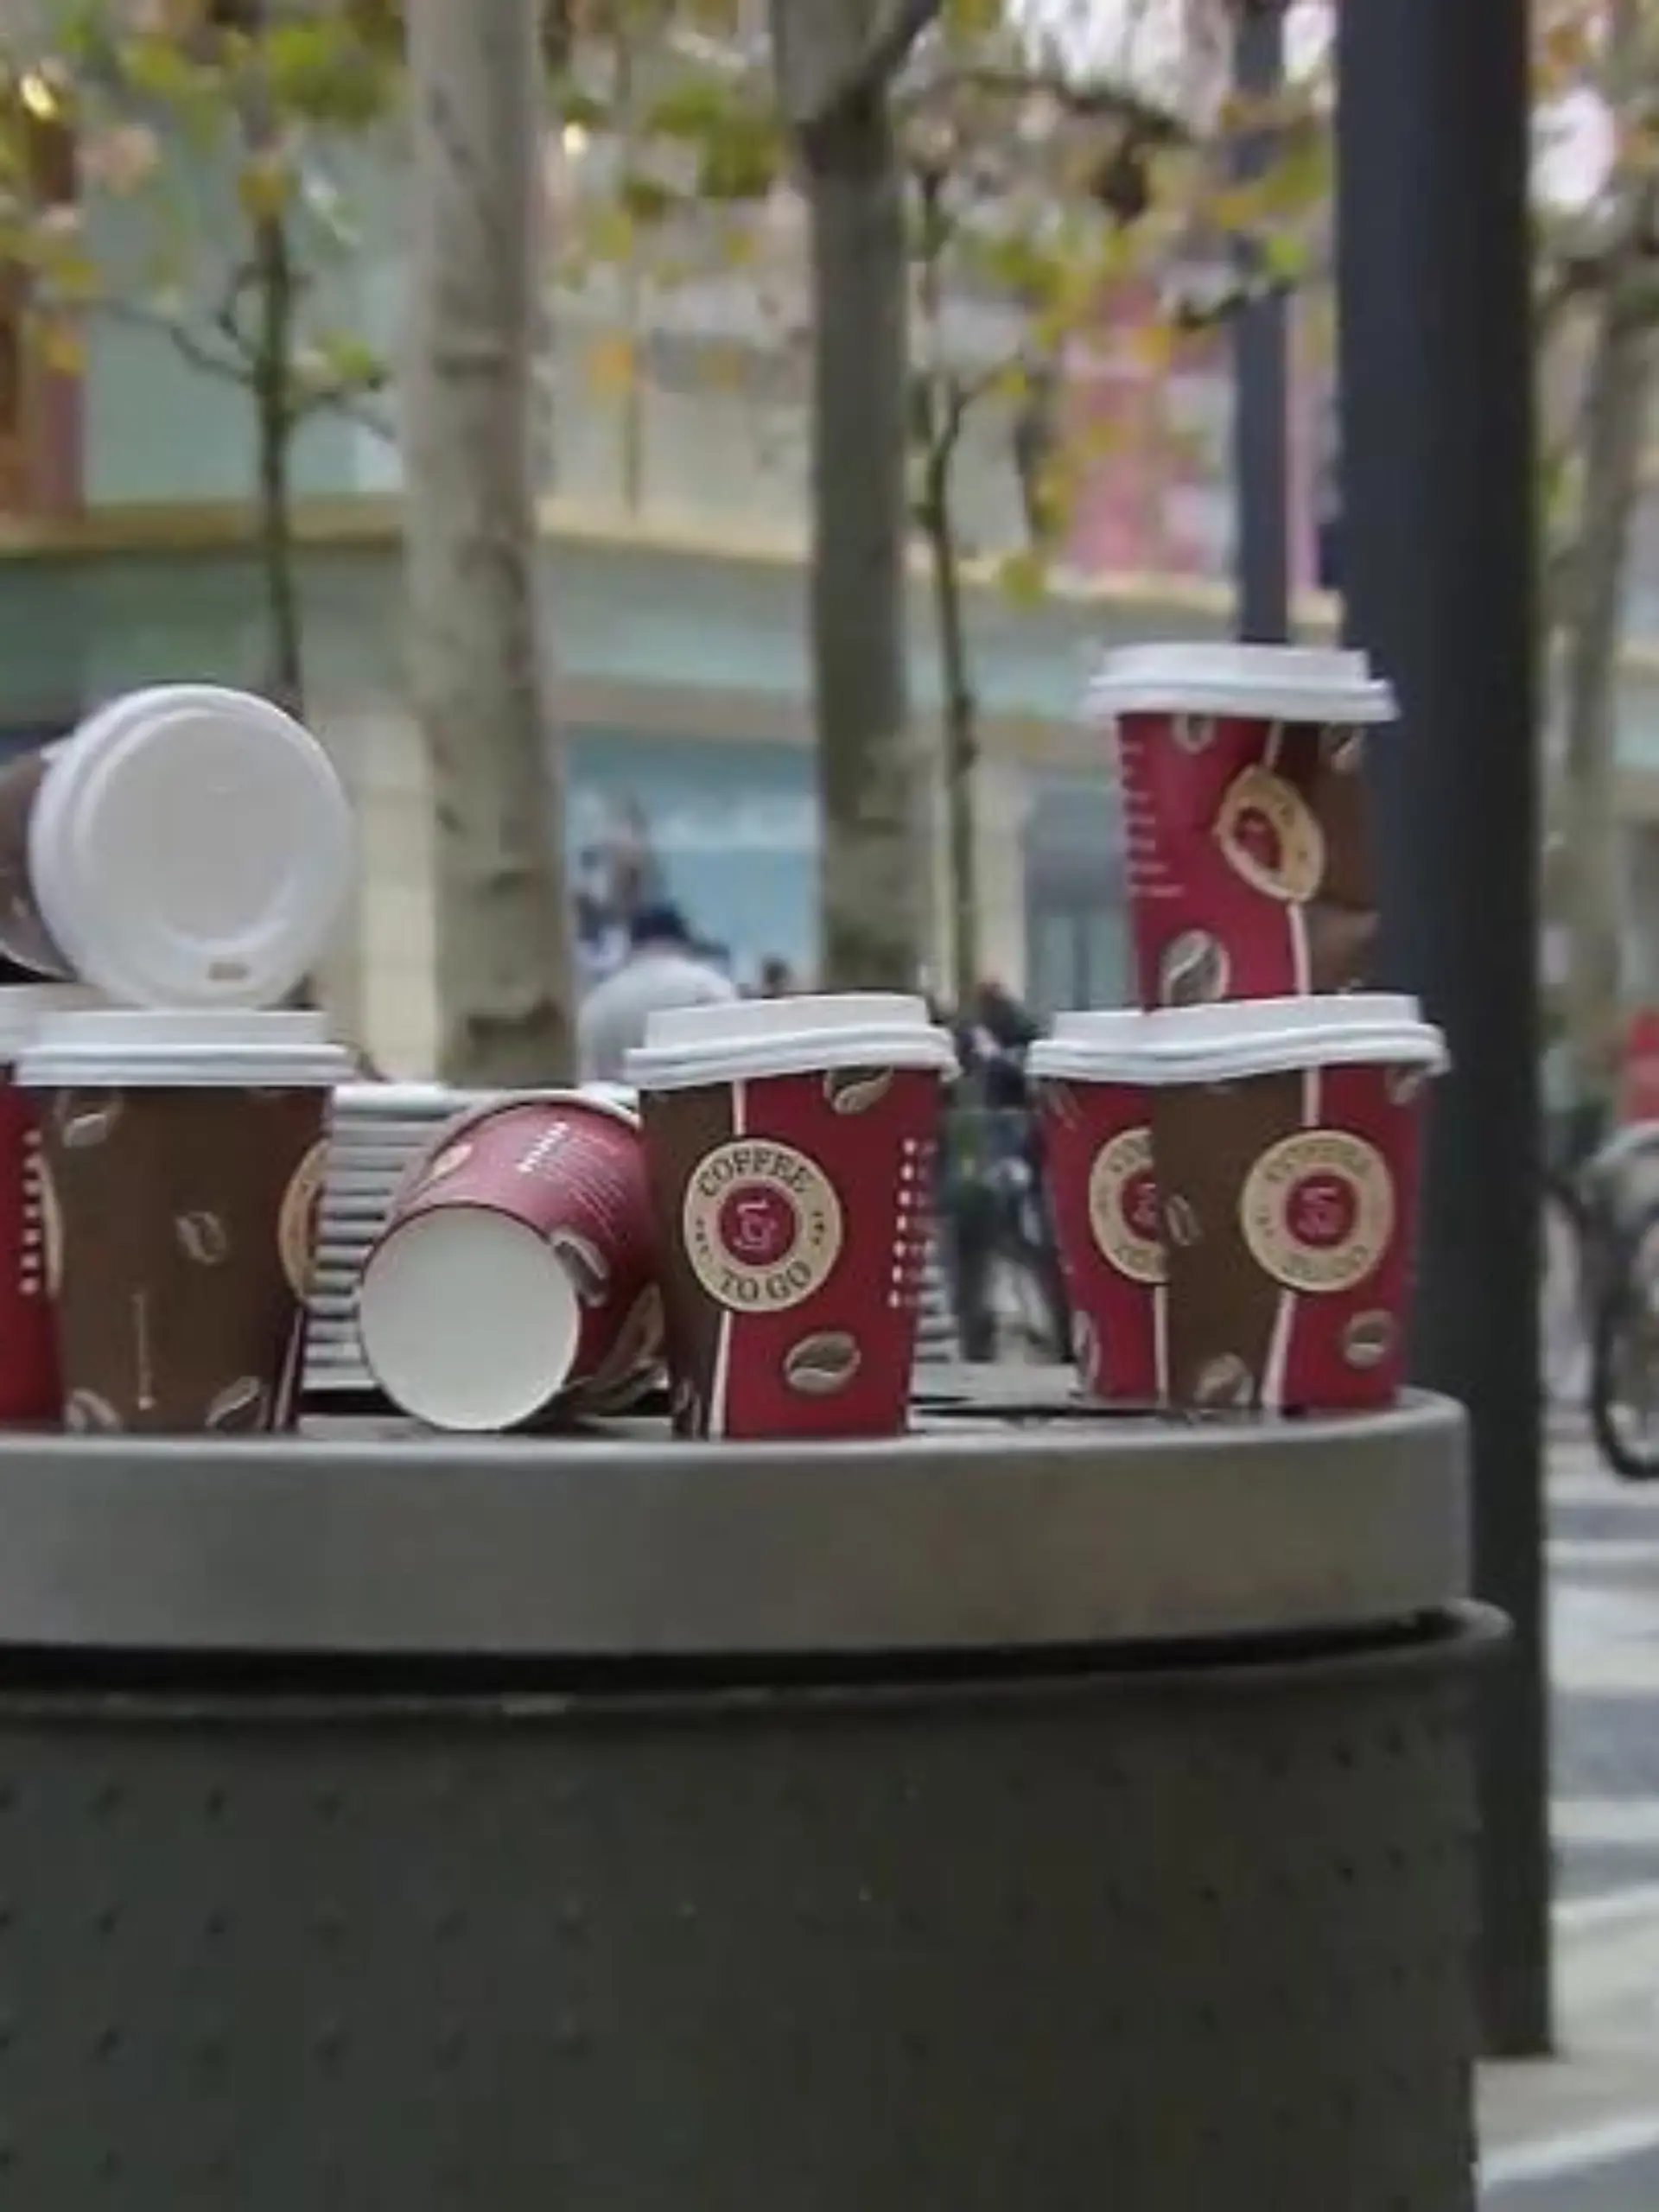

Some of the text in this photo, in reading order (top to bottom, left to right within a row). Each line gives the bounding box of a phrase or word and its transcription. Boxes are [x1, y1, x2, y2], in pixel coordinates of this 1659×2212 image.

[697, 1147, 814, 1196] COFFEE
[721, 1261, 812, 1302] TO GO
